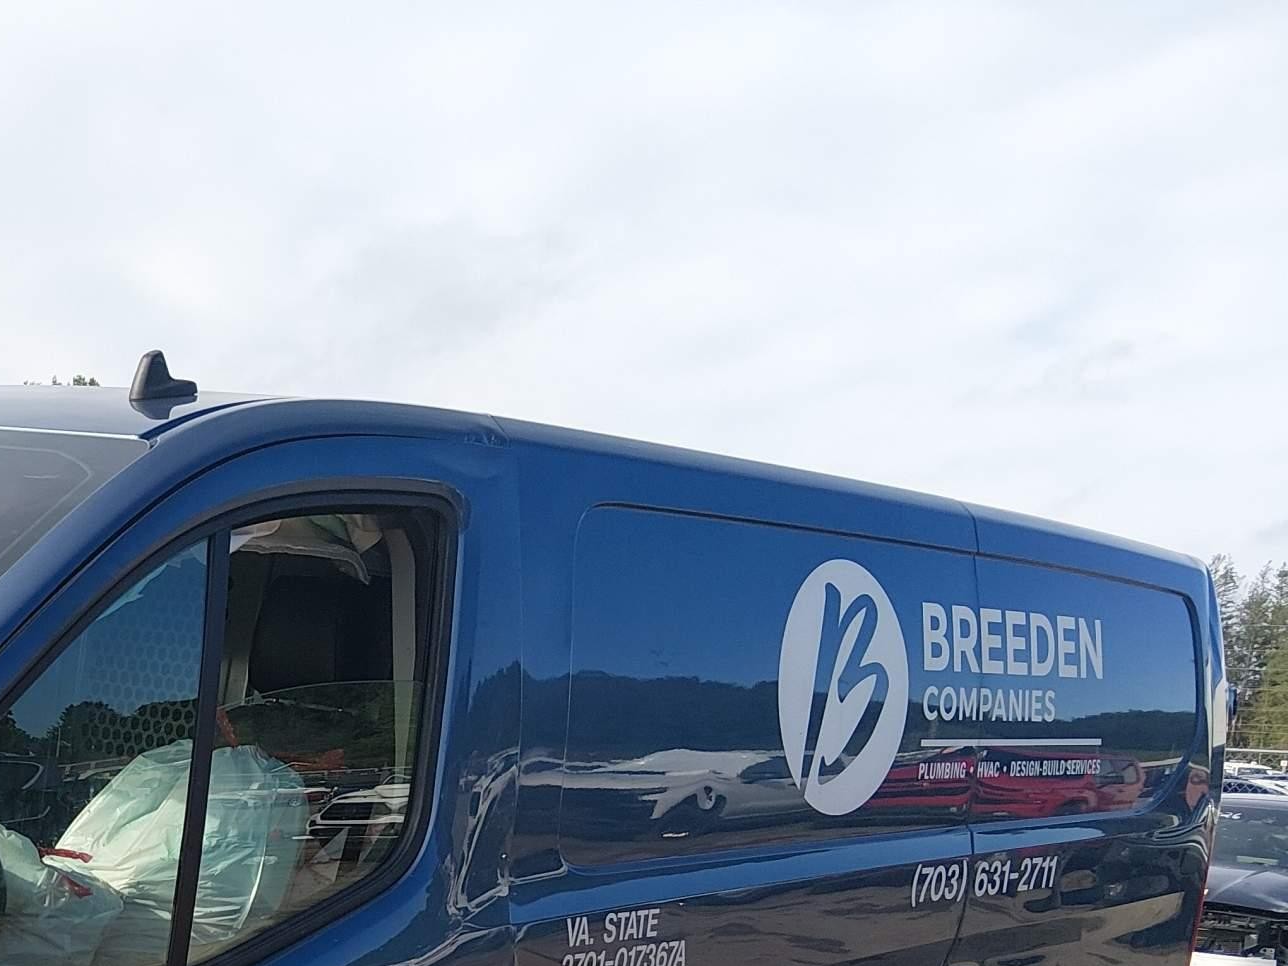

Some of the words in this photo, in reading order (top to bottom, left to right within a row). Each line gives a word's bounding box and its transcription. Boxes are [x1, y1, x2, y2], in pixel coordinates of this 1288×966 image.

[922, 601, 1104, 680] BREEDEN
[922, 685, 1056, 723] COMPANIES
[917, 761, 967, 780] PLUMBING
[976, 761, 1001, 778] HVAC
[1009, 759, 1065, 777] DESIGN-BUILD
[1066, 758, 1102, 775] SERVICES
[911, 859, 969, 908] (703)
[974, 855, 1059, 897] 631-2711
[566, 916, 594, 948] VA.
[603, 908, 661, 944] STATE
